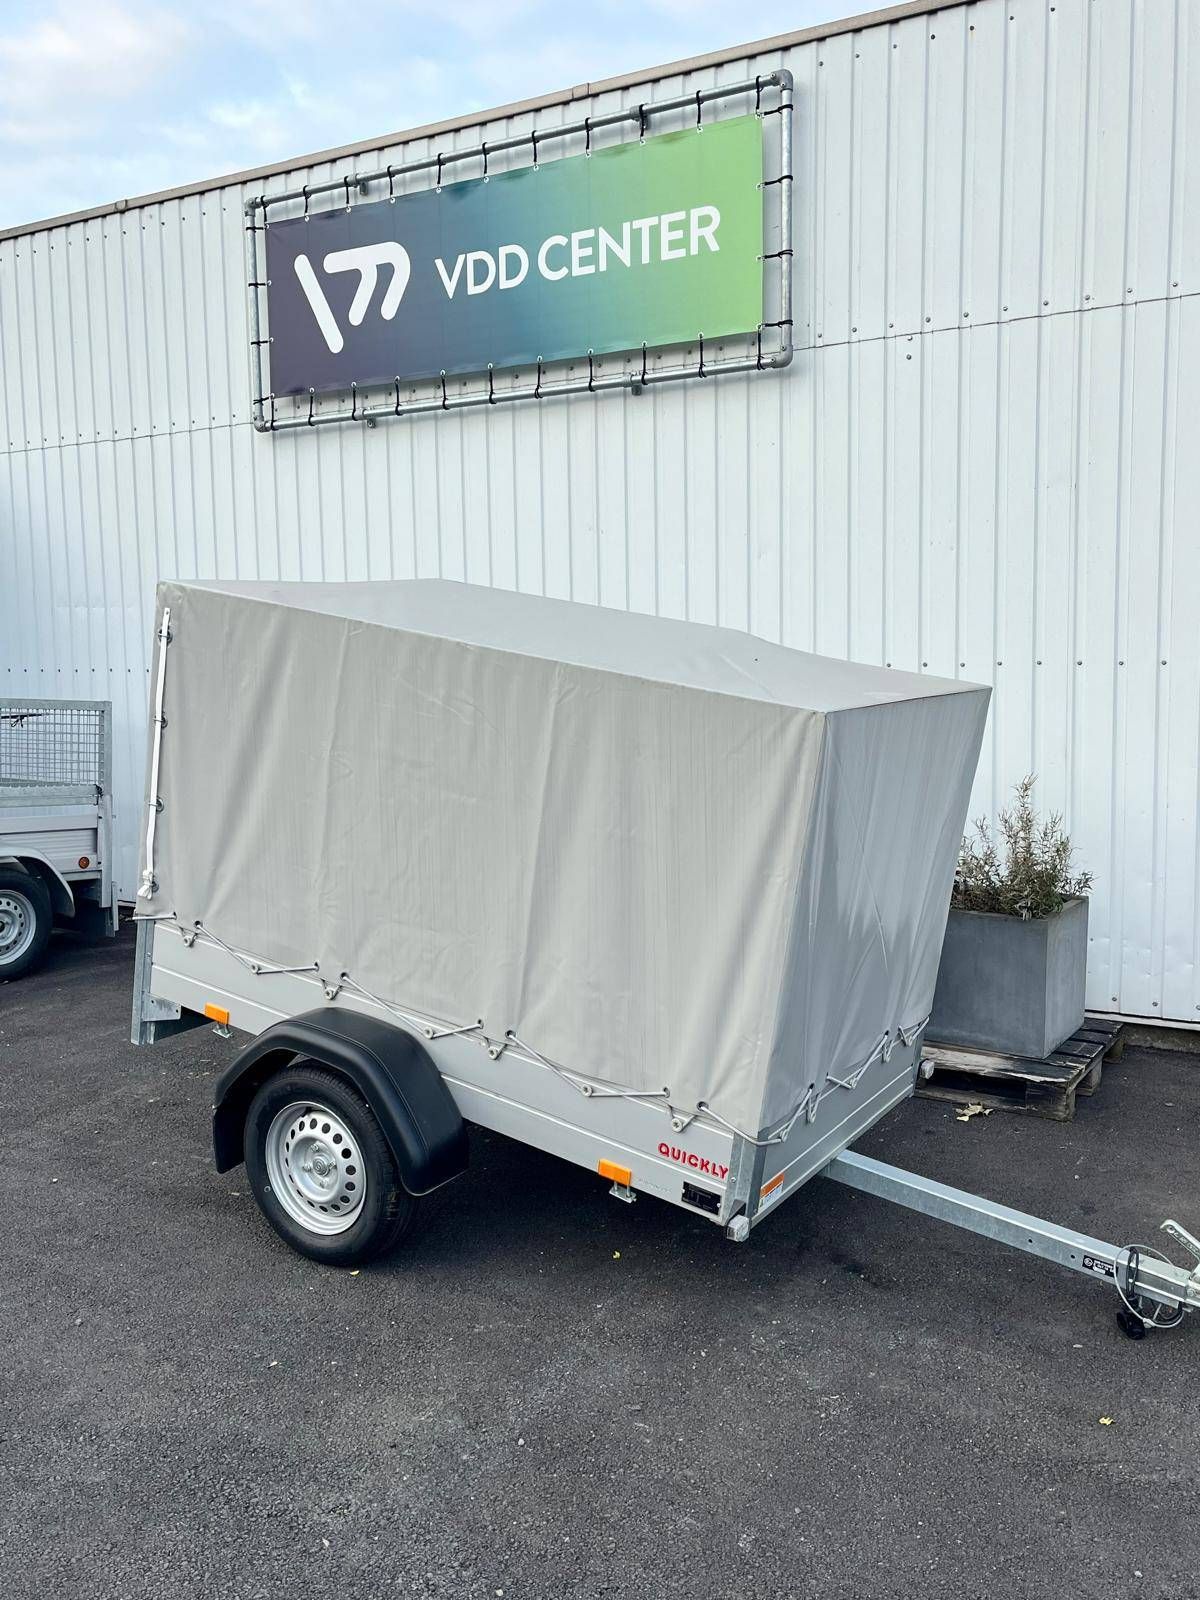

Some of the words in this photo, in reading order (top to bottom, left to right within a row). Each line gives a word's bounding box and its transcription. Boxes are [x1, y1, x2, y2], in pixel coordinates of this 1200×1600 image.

[434, 244, 528, 299] VDD
[538, 205, 720, 281] CENTER
[658, 1142, 728, 1179] QUICKLY
